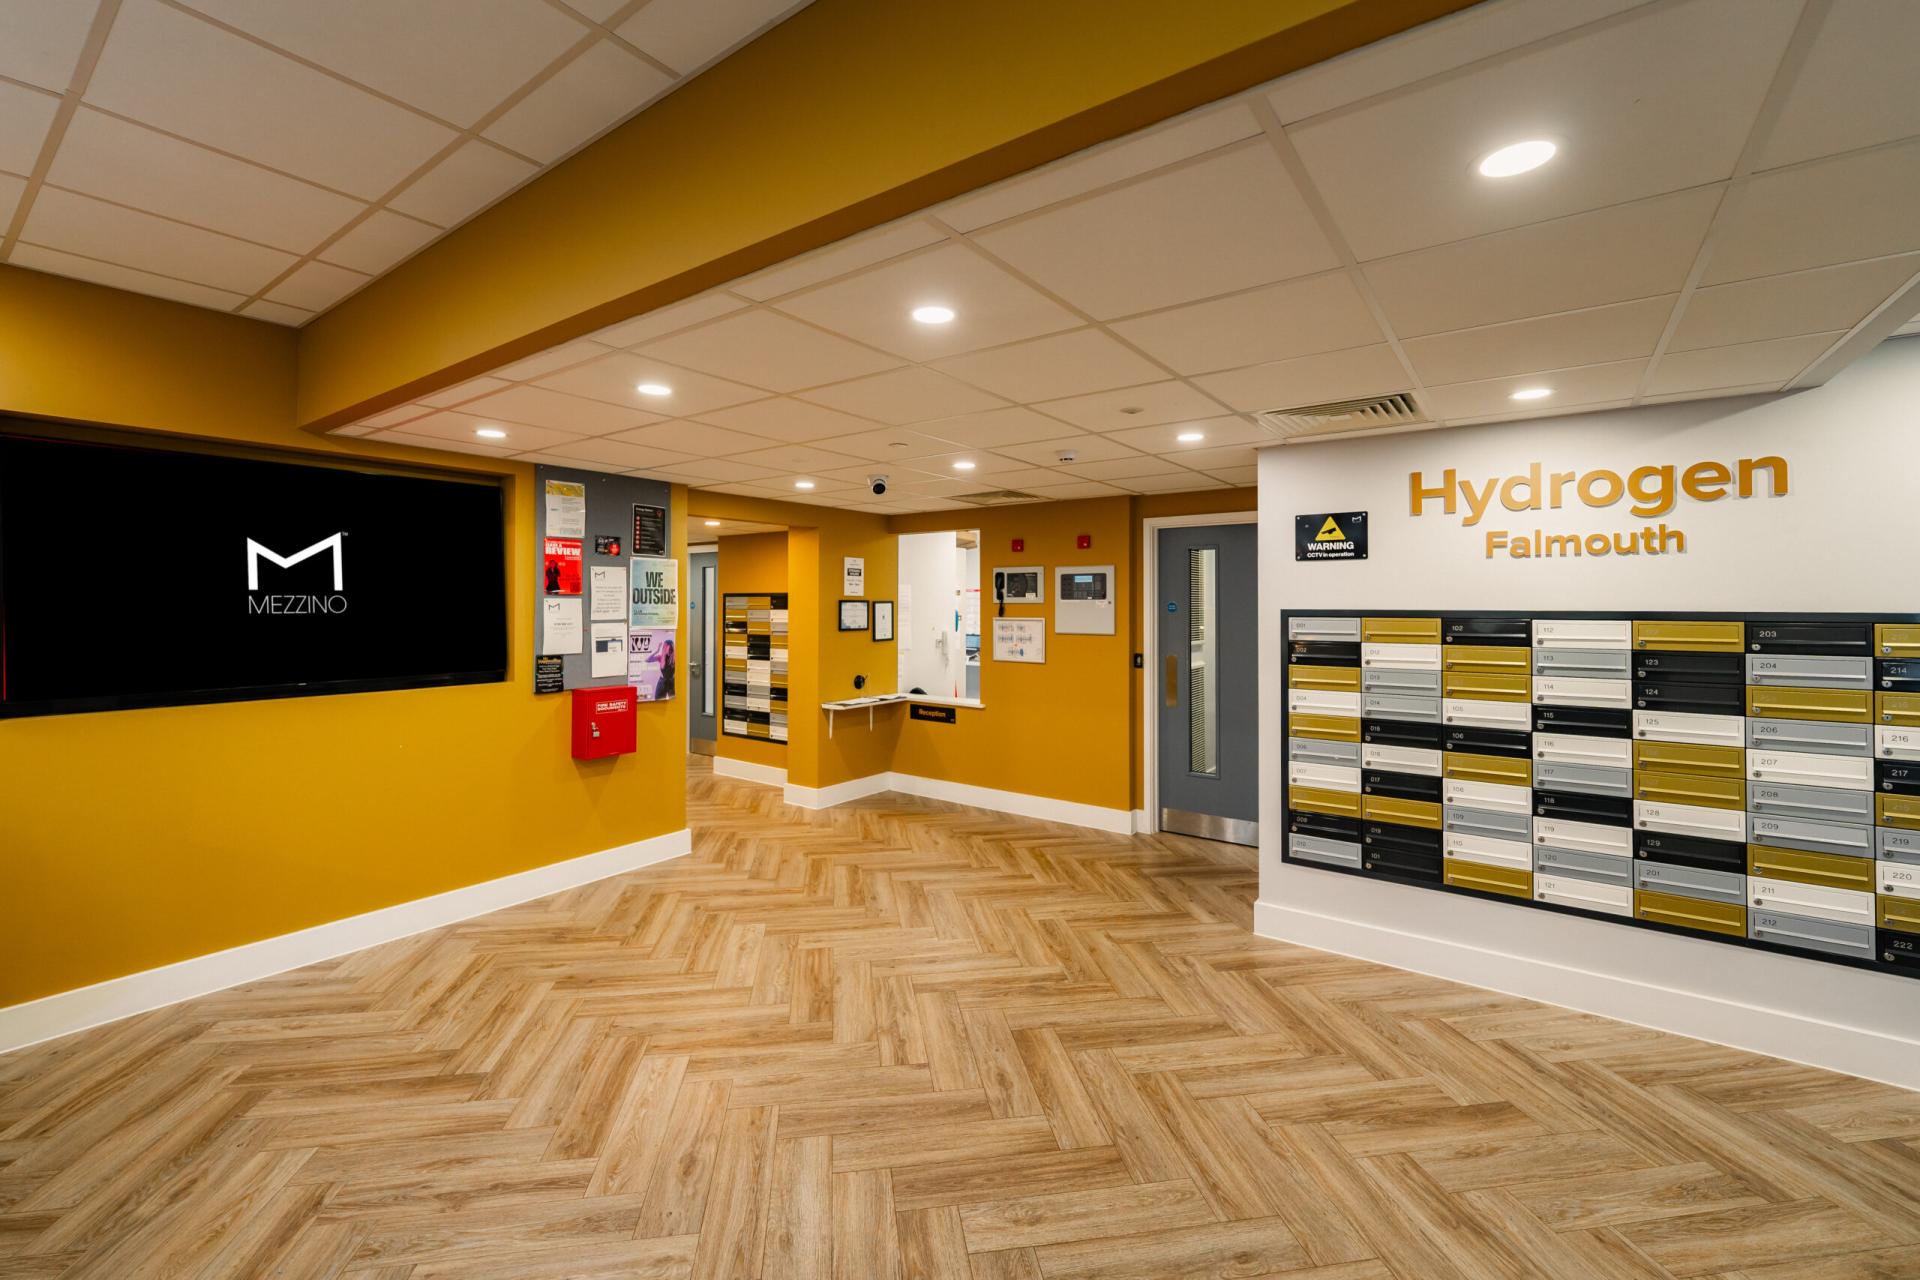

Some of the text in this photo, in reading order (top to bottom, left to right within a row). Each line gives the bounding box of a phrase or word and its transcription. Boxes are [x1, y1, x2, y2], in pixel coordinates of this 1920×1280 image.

[1409, 456, 1789, 527] Hydrogen
[1307, 542, 1354, 550] WARNING
[1486, 524, 1685, 560] Falmouth
[546, 548, 580, 556] REVIEW
[646, 571, 663, 588] WE
[632, 588, 676, 604] OUTSIDE
[248, 595, 347, 614] MEZZINO
[1892, 872, 1912, 880] 220
[1893, 941, 1912, 949] 222
